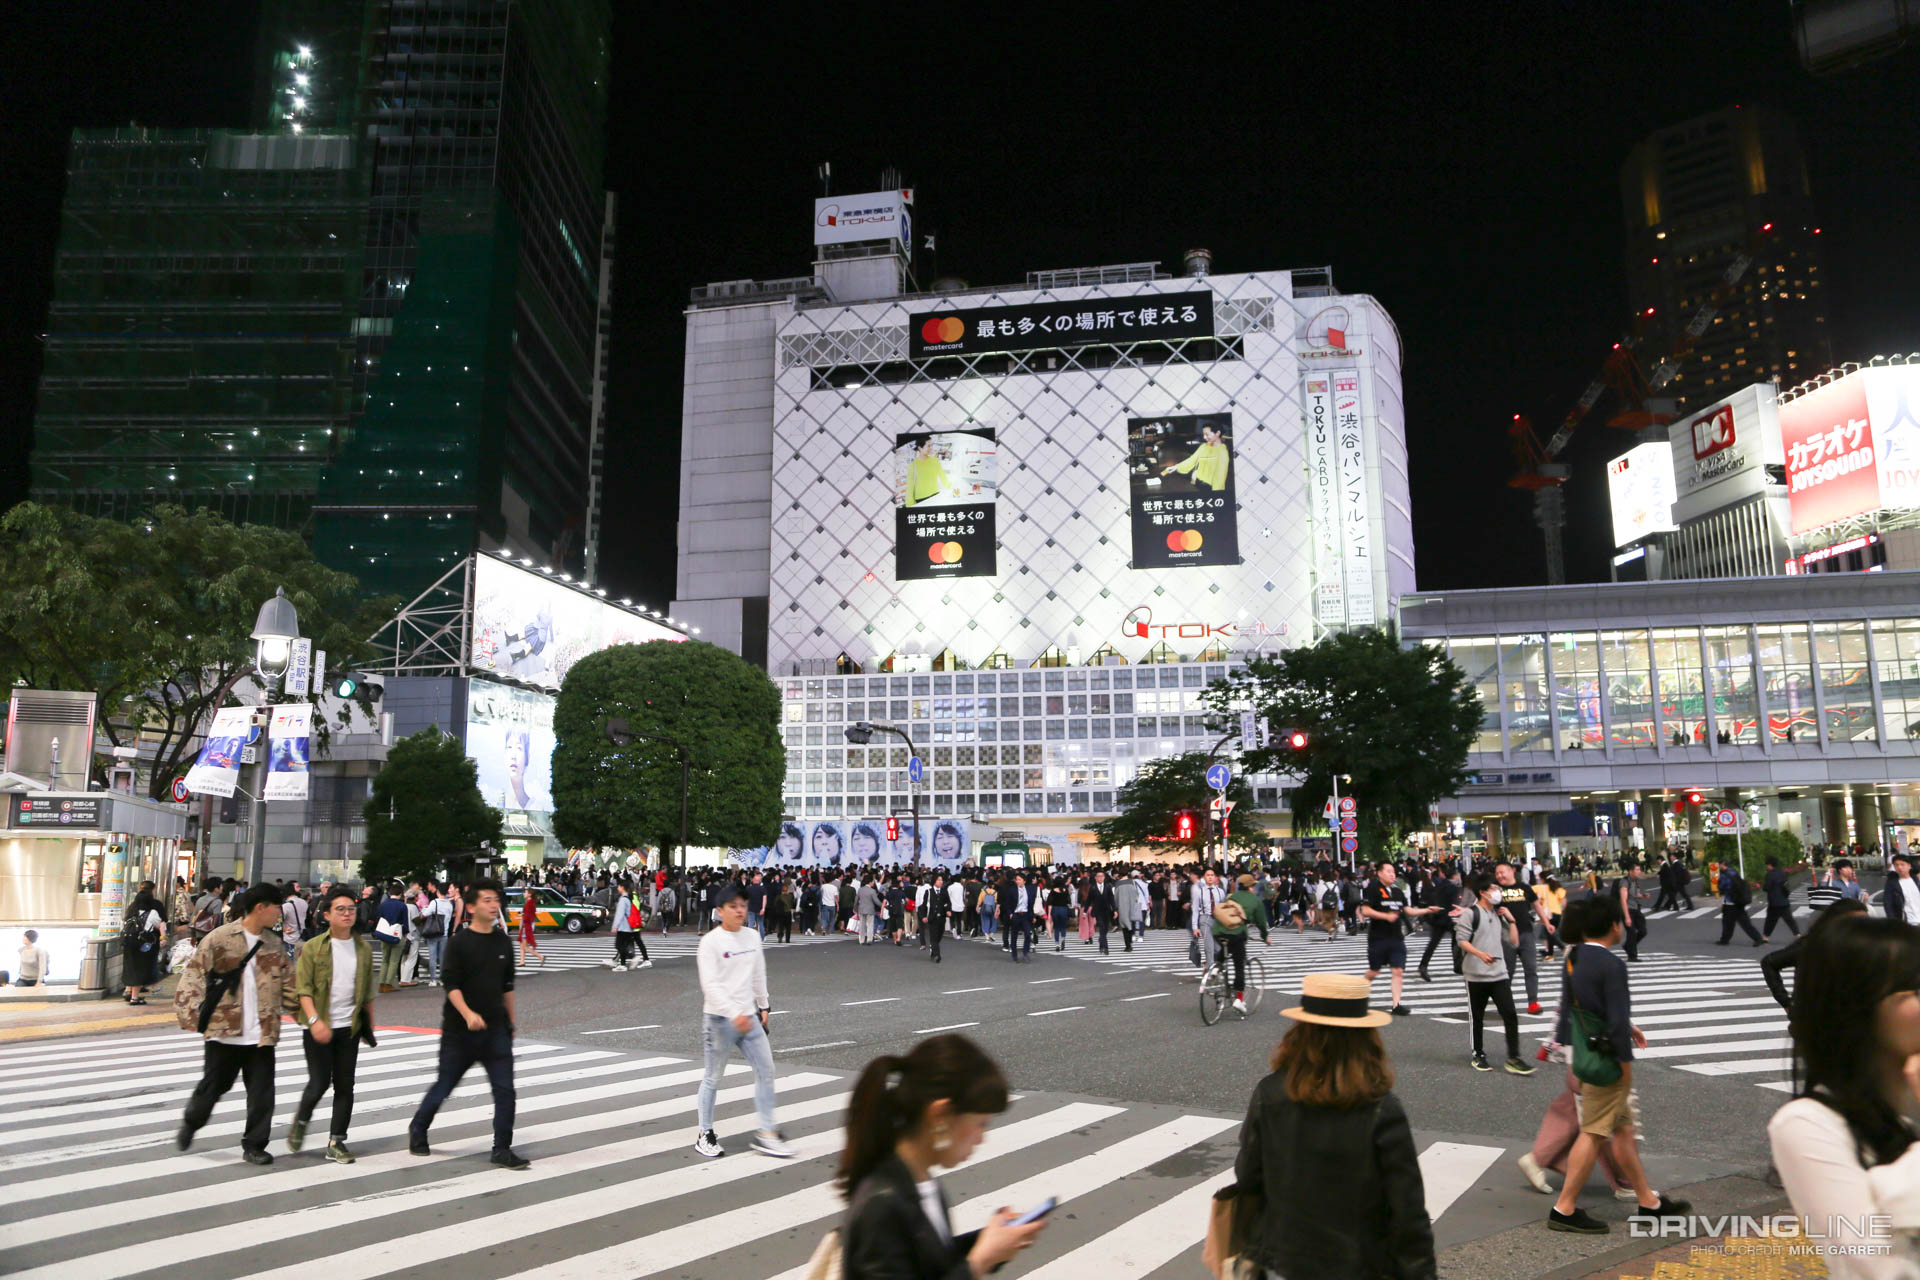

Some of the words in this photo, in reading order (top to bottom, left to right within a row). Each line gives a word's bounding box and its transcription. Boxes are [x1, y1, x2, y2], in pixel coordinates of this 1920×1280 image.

[839, 215, 895, 226] TOKYU
[976, 305, 1198, 338] 最も多くの場所で使える
[923, 342, 963, 351] mastercard
[1298, 349, 1362, 359] TOKYU
[1313, 395, 1326, 443] TOKYU
[1788, 418, 1868, 473] カラオケ
[1316, 446, 1329, 486] CARD
[1702, 455, 1745, 481] MasterCard
[1708, 453, 1727, 469] VISA
[1791, 446, 1873, 494] JOYSOUND
[1340, 412, 1368, 557] 渋谷パンマルシェ
[1142, 498, 1224, 511] 世界で最も多くの
[907, 511, 985, 524] 世界で最も多くの
[1152, 512, 1215, 525] 場所で使える
[916, 525, 975, 537] 場所で使える
[295, 642, 308, 691] 渋谷駅前
